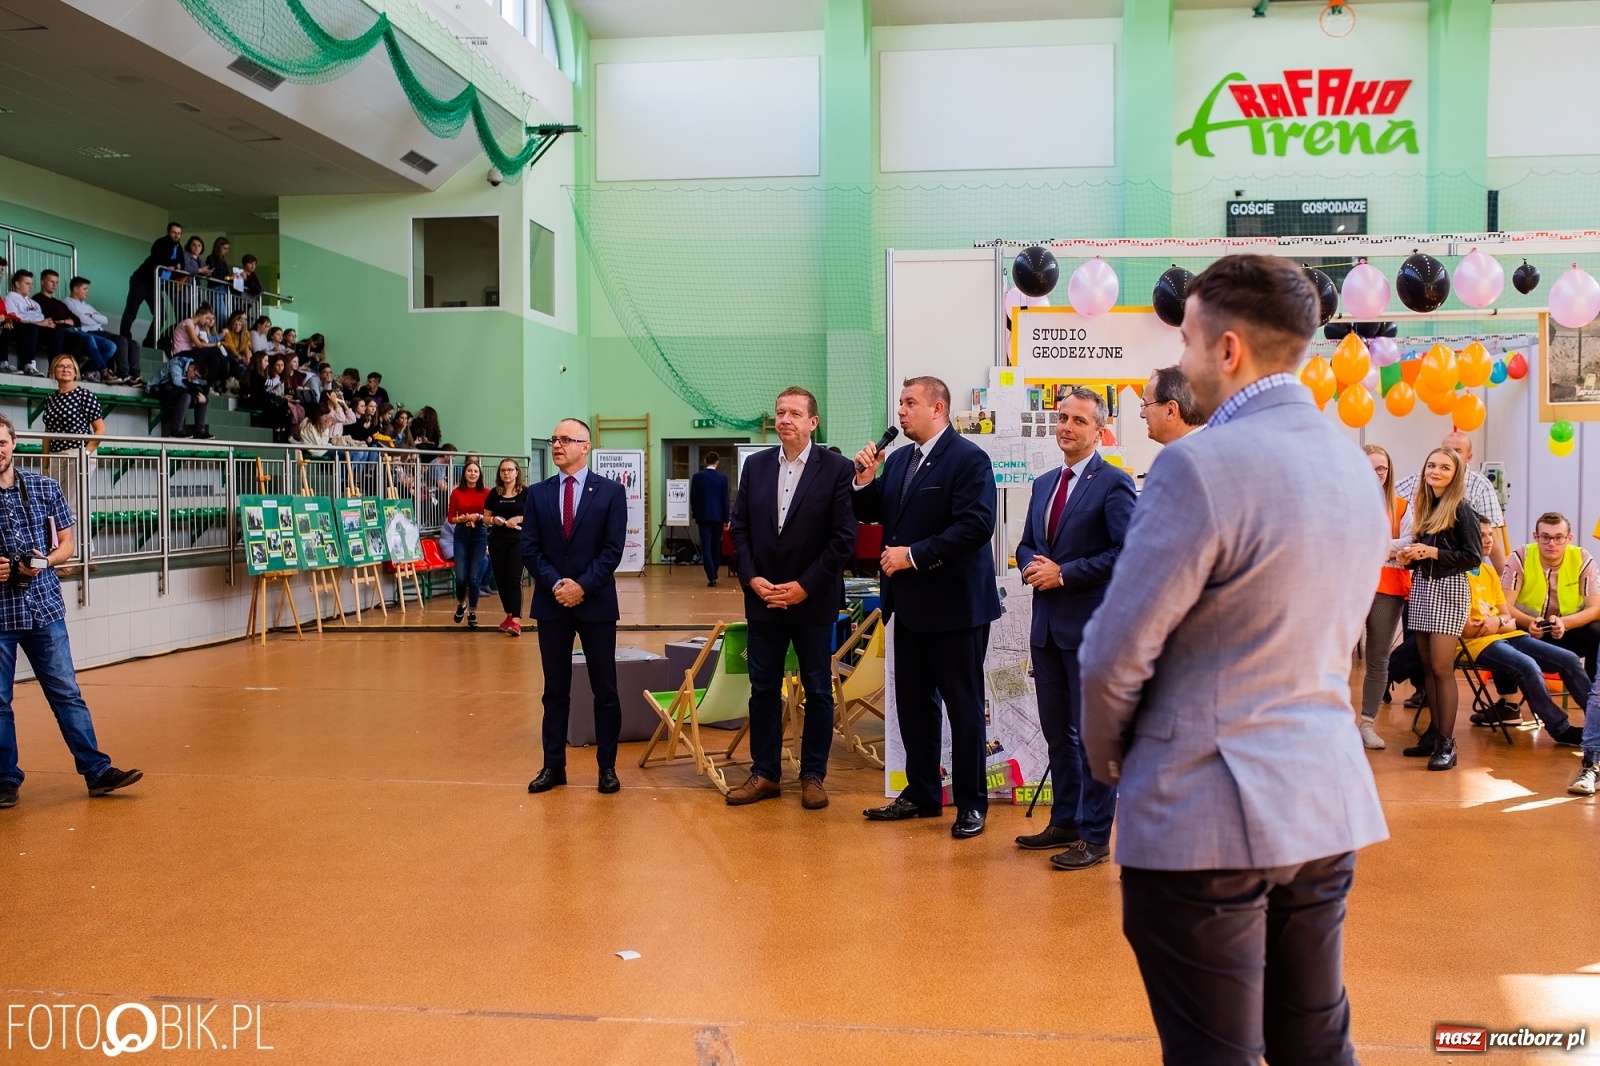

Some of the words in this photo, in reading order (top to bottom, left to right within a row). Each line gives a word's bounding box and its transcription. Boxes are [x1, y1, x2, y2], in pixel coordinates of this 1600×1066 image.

[1176, 72, 1420, 157] Arena
[1230, 201, 1275, 216] GOŚCIE
[1301, 200, 1367, 215] GOSPODARZE
[1032, 328, 1087, 341] STUDIO
[1032, 346, 1123, 359] GEODEZYJNE
[992, 461, 1027, 469] ECHNIK
[995, 473, 1035, 483] ODETA
